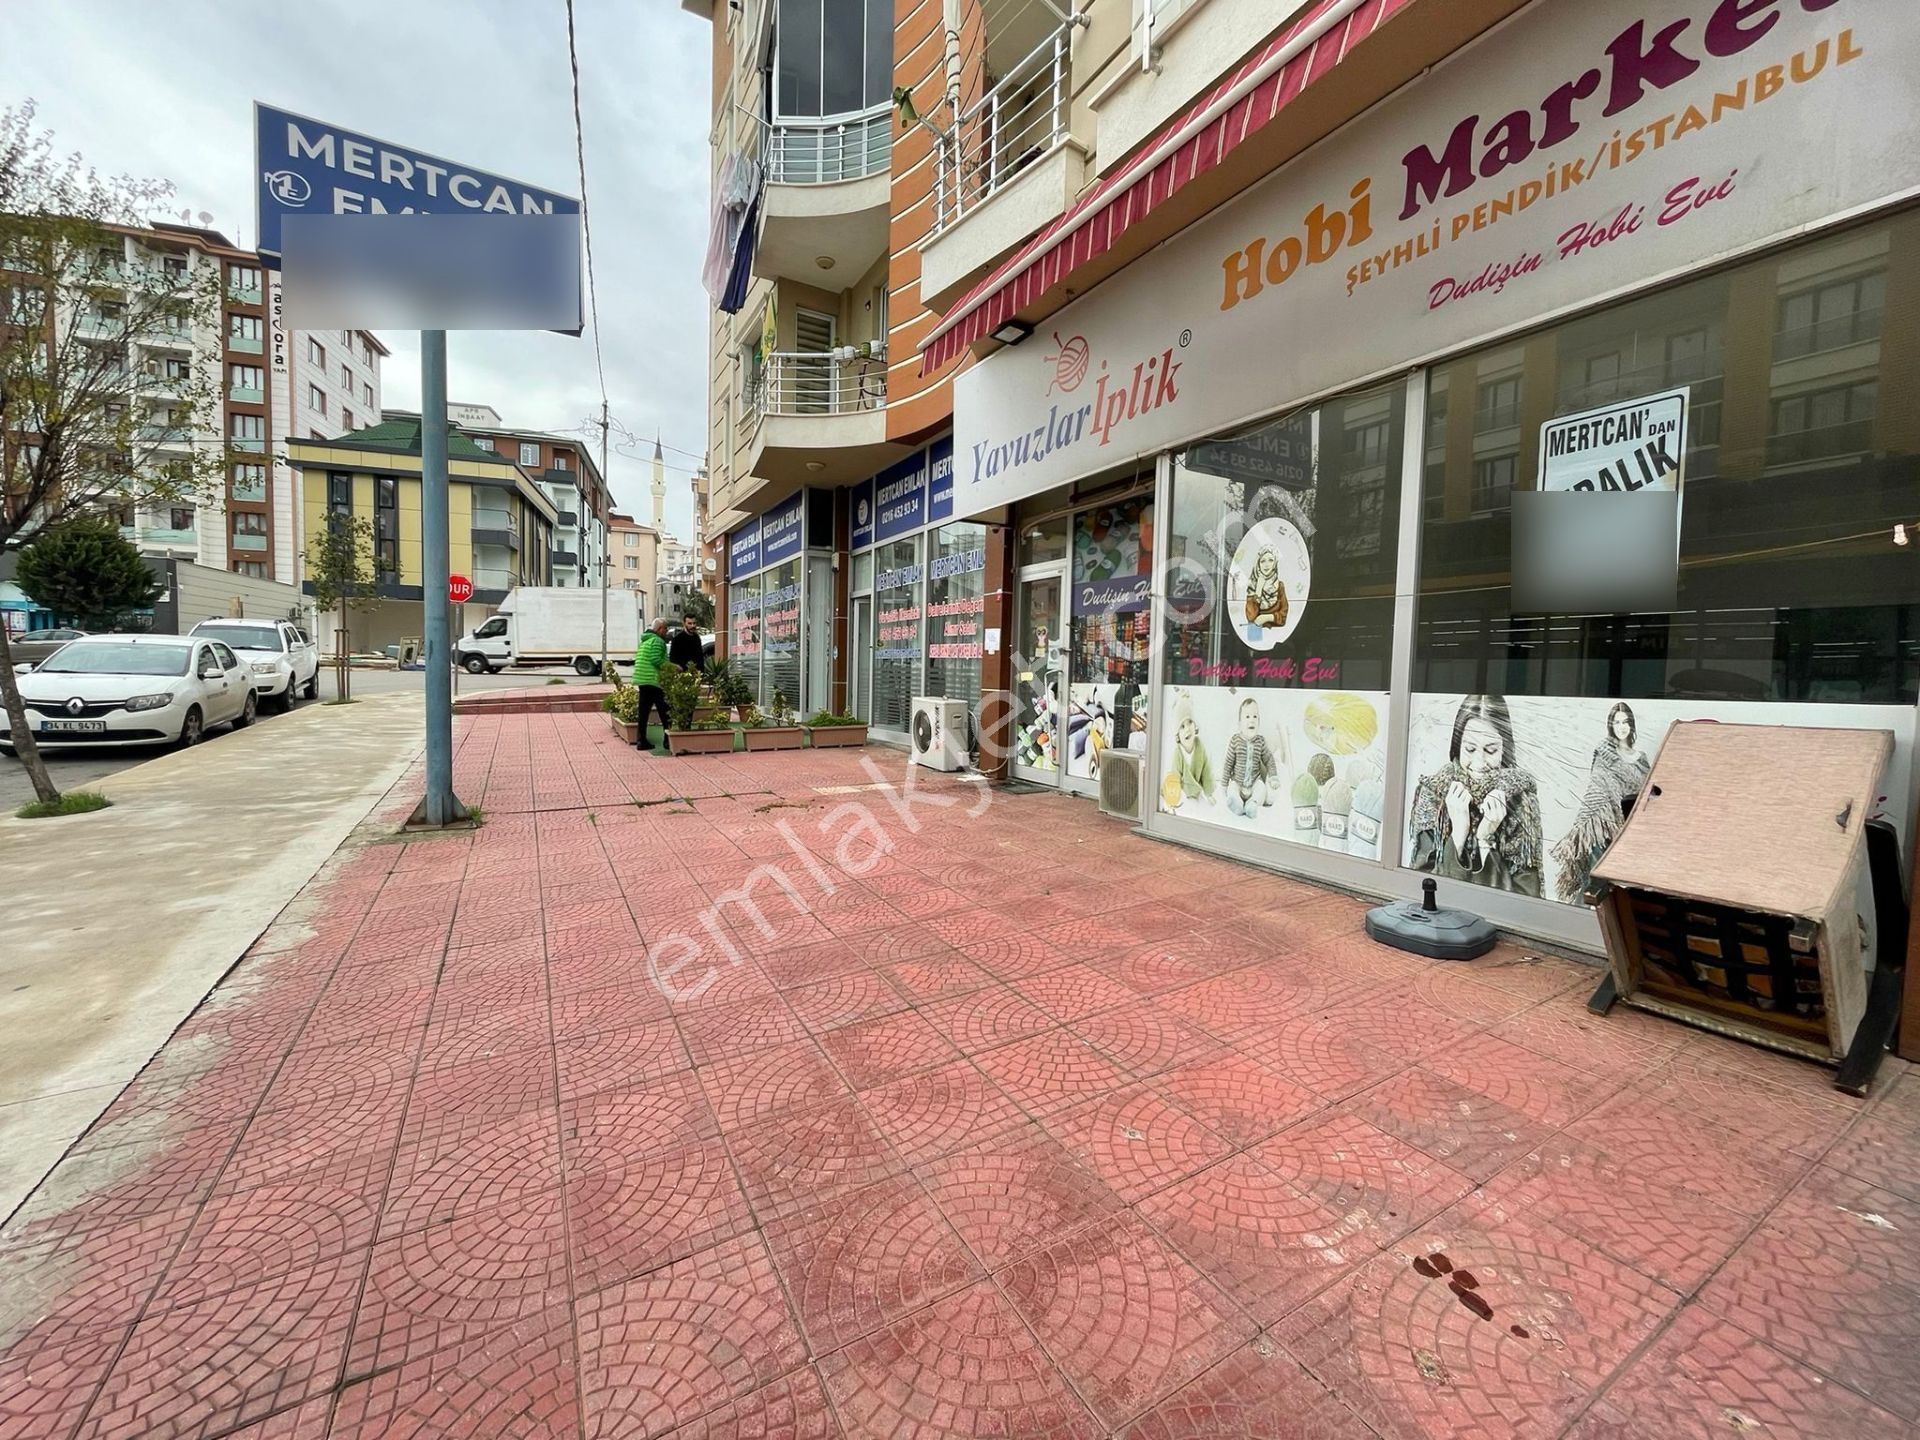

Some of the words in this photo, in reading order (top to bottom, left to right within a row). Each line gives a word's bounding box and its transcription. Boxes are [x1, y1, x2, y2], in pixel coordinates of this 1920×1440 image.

[287, 122, 553, 214] MERTCAN
[1219, 177, 1373, 311] Hobi
[1398, 0, 1841, 221] Marke
[1346, 212, 1441, 296] ŞEYHLİ
[1428, 256, 1542, 311] Dudişin
[1543, 203, 1645, 262] Hobi
[1656, 168, 1740, 226] Evi
[971, 404, 1091, 484] Yavuzlar
[1090, 347, 1183, 447] İplik
[877, 479, 904, 507] MERTCAN
[1188, 657, 1249, 683] Dudişin
[1252, 657, 1296, 680] Hobi
[1301, 658, 1338, 683] Evi
[47, 722, 59, 730] 34
